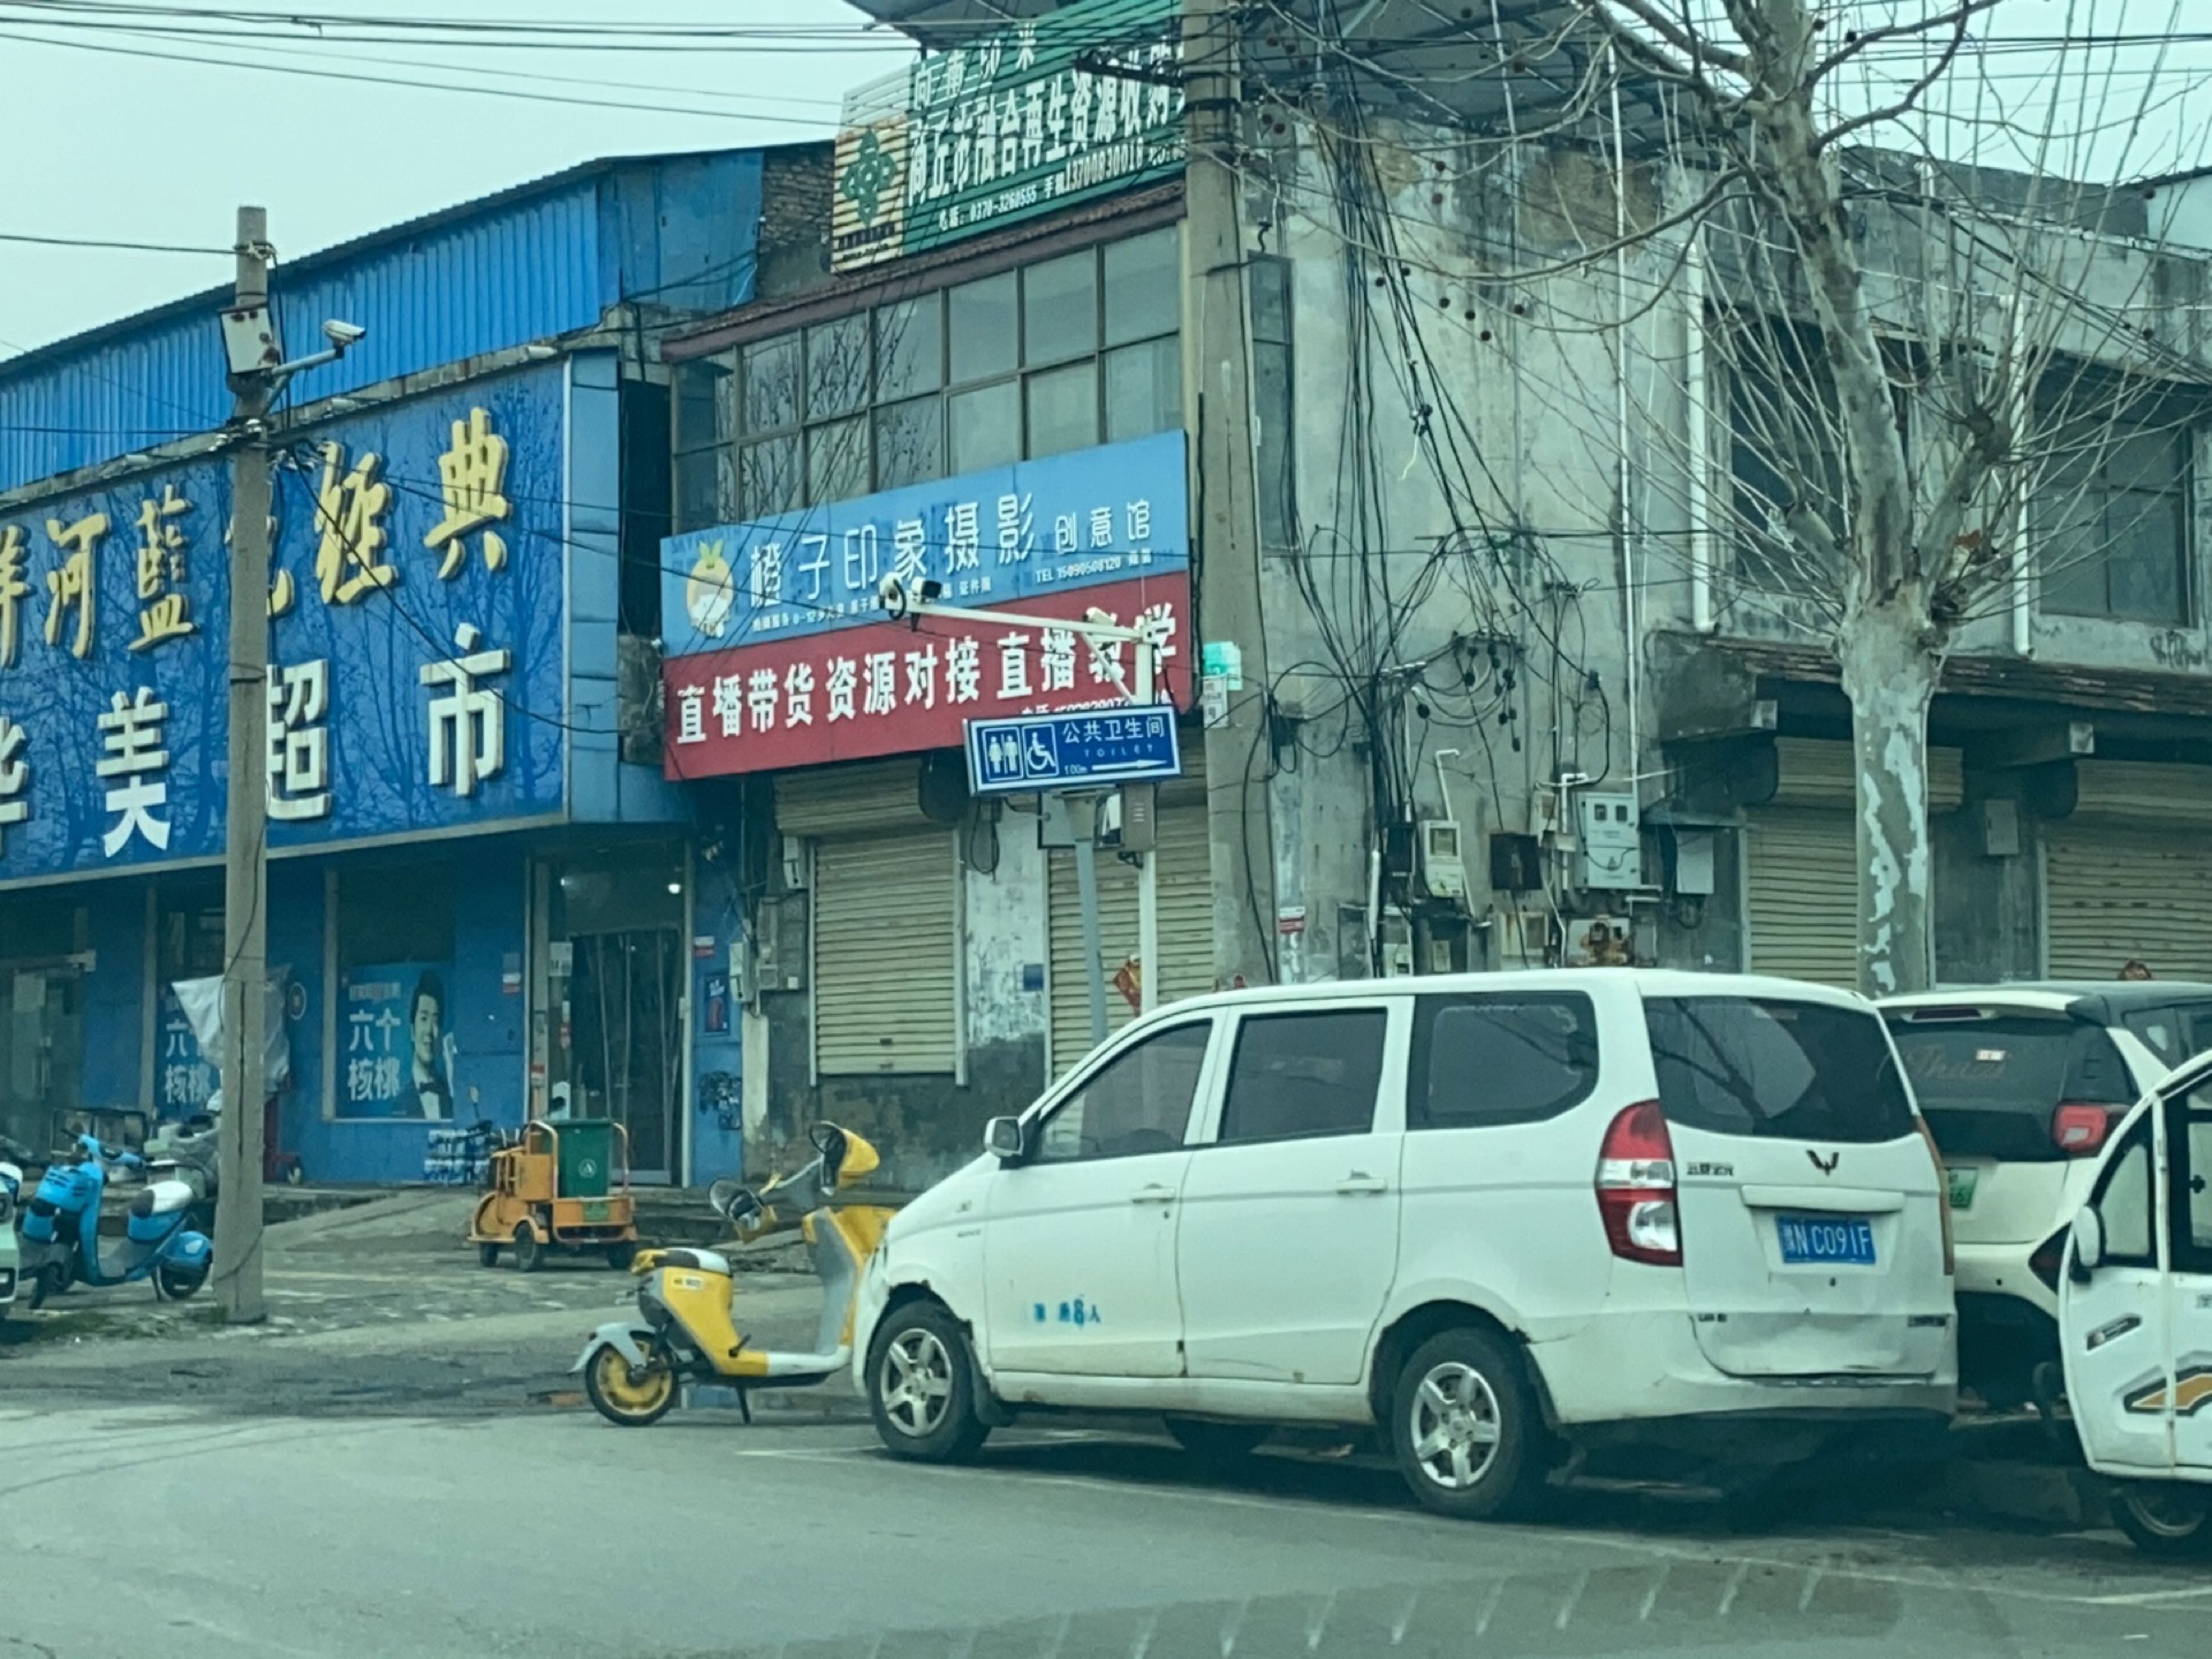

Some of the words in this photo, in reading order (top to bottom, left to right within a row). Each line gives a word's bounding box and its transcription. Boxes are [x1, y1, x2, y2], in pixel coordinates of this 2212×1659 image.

[750, 492, 1034, 609] 橙子印象摄影
[1055, 499, 1150, 556] 创意馆
[677, 634, 981, 744] 直播带货资源对接
[1063, 716, 1165, 743] 公共卫生间
[1084, 744, 1153, 758] TOILET
[349, 1007, 401, 1051] 六个
[348, 1057, 401, 1101] 核桃
